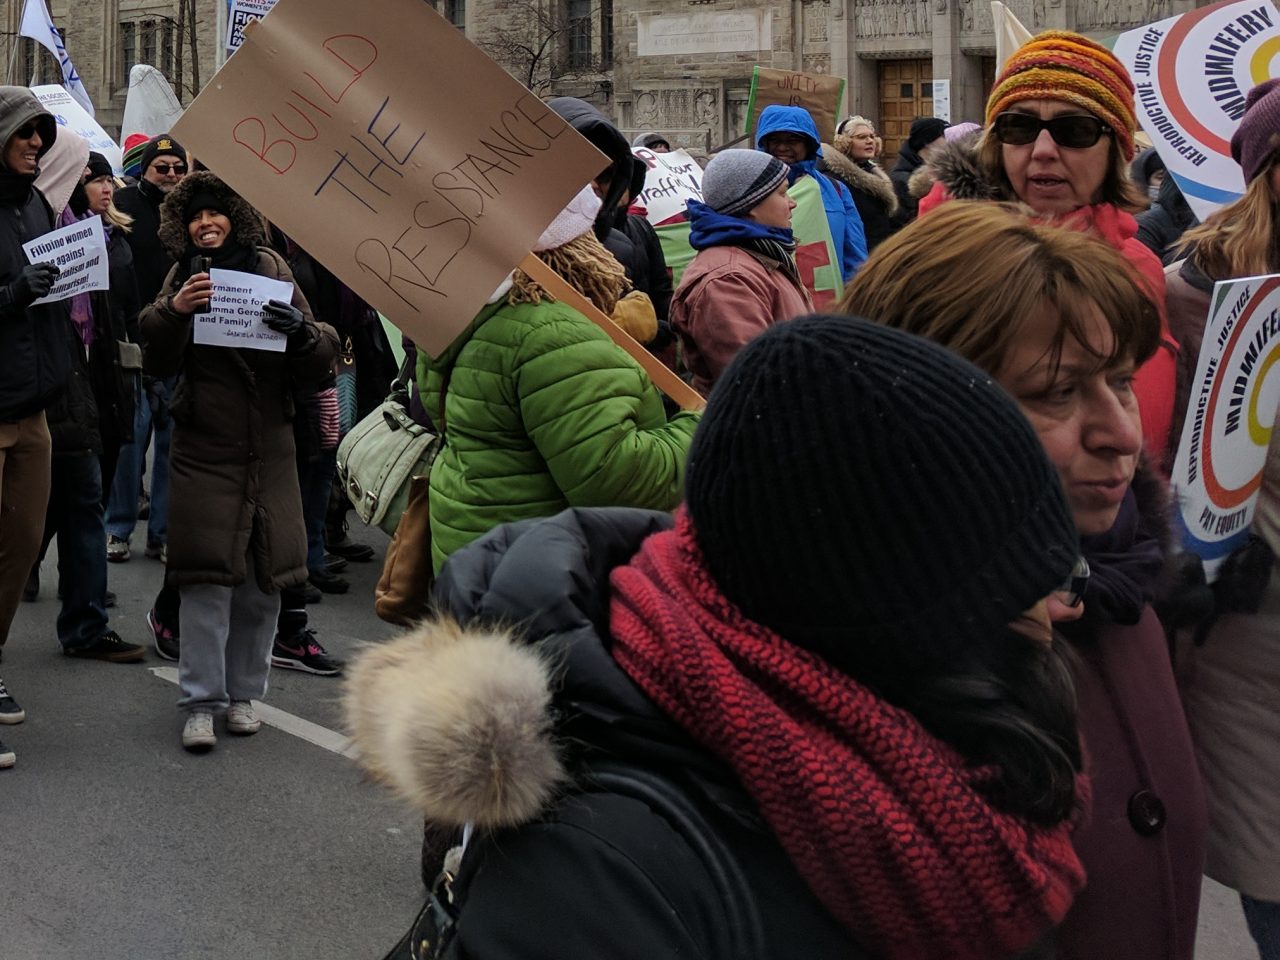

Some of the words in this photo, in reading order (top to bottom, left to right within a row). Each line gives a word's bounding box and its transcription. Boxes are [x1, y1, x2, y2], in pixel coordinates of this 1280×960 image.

[236, 1, 262, 10] WOMEN'S
[233, 30, 244, 38] AN
[234, 24, 243, 32] FO
[1134, 27, 1164, 76] JUSTICE
[1205, 5, 1274, 121] MIDWIFERY
[777, 74, 819, 94] UNITY
[233, 34, 378, 175] BUILD
[1138, 81, 1207, 167] REPRODUCTIVE
[314, 96, 426, 214] THE
[354, 95, 568, 312] RESISTANCE
[29, 238, 64, 258] Filipino
[65, 227, 93, 245] women
[56, 247, 85, 266] against
[52, 264, 85, 281] erialism
[85, 255, 100, 269] and
[209, 294, 248, 305] esidence
[251, 296, 263, 306] for
[213, 285, 252, 295] rmanent
[212, 306, 234, 315] mma
[219, 316, 252, 328] Family!
[1187, 357, 1218, 485] REPRODUCTIVE
[1217, 284, 1251, 351] JUSTICE
[1224, 307, 1280, 437] MIDWIFE
[1199, 505, 1217, 531] PAY
[1215, 506, 1247, 536] EQUITY
